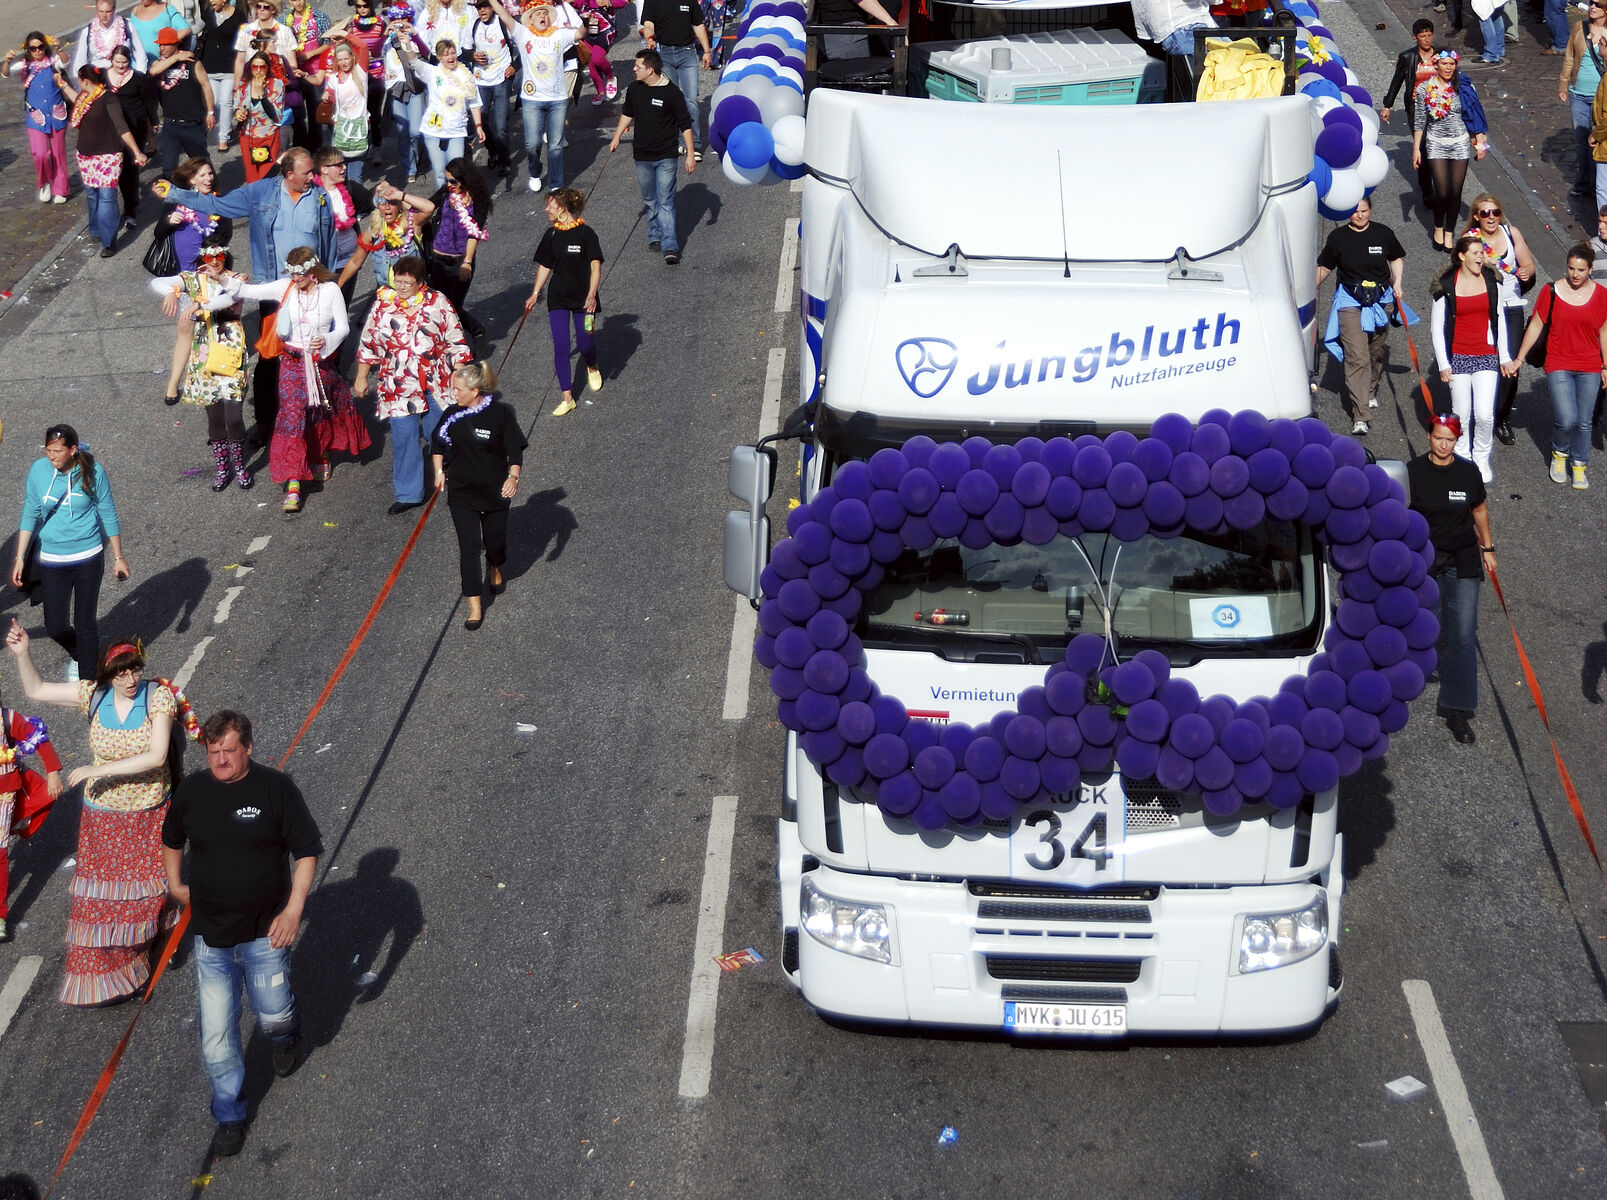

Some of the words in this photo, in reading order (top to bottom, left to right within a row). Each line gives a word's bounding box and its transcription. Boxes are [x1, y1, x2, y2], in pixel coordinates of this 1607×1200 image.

[1111, 356, 1237, 389] Nutzfahrzeuge
[1221, 612, 1233, 621] 34
[930, 686, 1019, 702] Vermietun
[1024, 810, 1114, 872] 34
[1017, 1006, 1050, 1025] MYK
[1065, 1008, 1087, 1026] JU
[1091, 1008, 1124, 1027] 615
